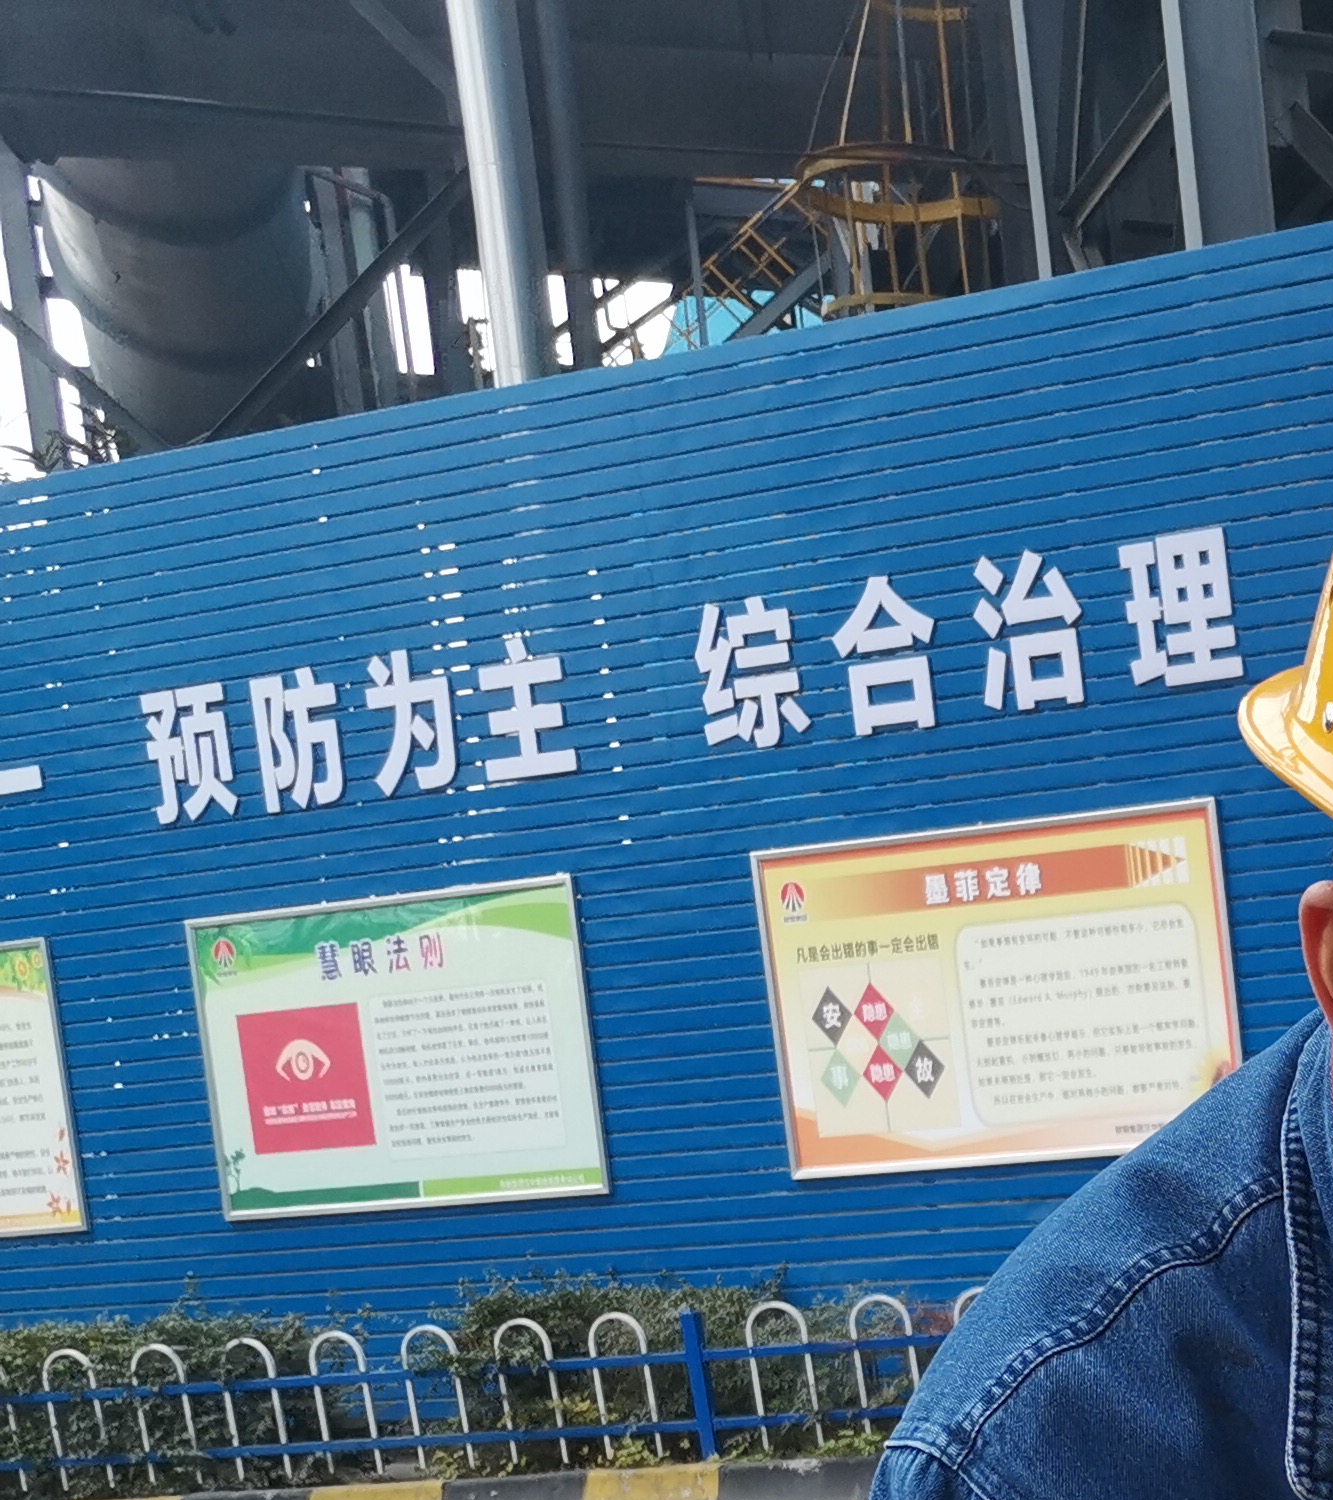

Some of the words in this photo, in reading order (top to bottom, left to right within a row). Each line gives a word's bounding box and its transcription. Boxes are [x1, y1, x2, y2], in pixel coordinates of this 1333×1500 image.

[140, 639, 578, 825] 预防为主
[695, 526, 1245, 749] 综合治理
[316, 931, 445, 981] 慧眼法则
[796, 934, 940, 965] 凡是会出错的事一定会出错
[823, 1002, 842, 1029] 安
